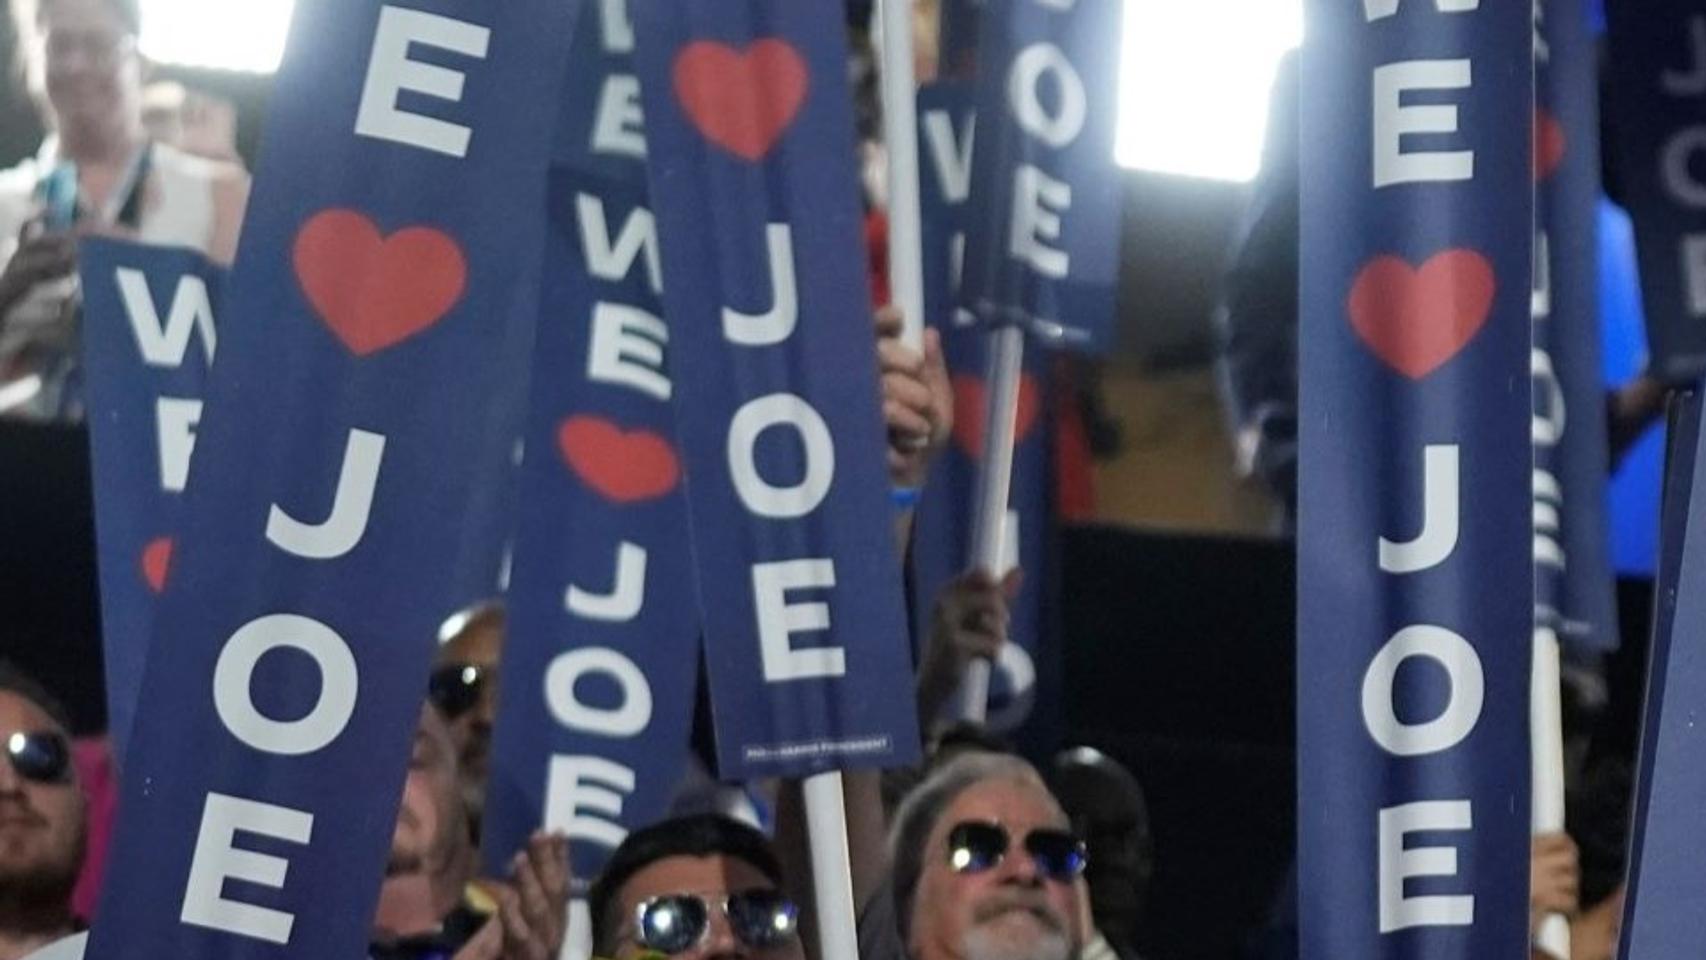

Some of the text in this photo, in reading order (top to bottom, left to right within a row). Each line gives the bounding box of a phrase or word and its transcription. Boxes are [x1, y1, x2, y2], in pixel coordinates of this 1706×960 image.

[354, 4, 491, 158] E
[1009, 0, 1087, 279] OE
[180, 428, 386, 945] JOE
[544, 192, 672, 849] WE JOE
[722, 223, 846, 683] JOE
[1361, 0, 1485, 933] E JOE
